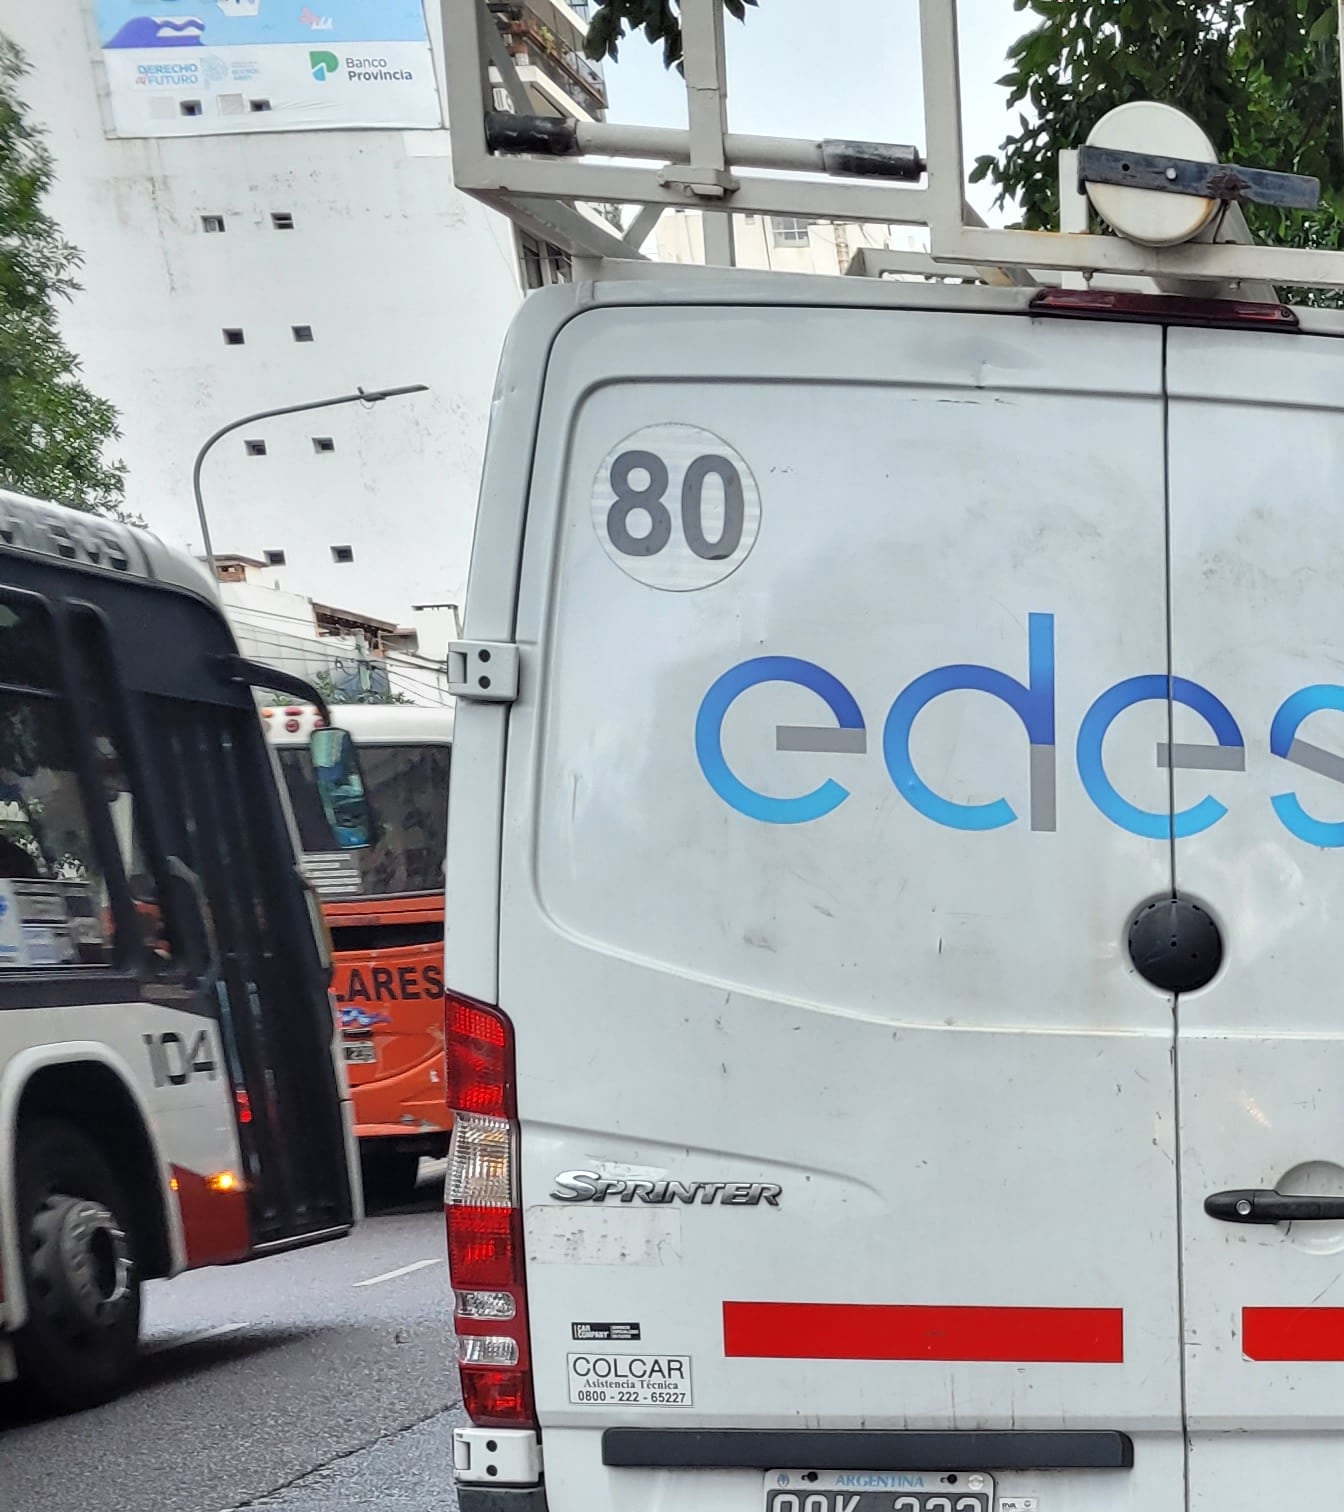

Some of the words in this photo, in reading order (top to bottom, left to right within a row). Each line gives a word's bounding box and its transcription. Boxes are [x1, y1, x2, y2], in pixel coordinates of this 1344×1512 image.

[138, 63, 198, 74] DERECHO
[346, 57, 387, 69] Banco
[148, 74, 199, 85] FUTURO
[348, 70, 413, 82] Provincia
[606, 449, 744, 561] 80
[336, 964, 445, 1001] ARES
[573, 1356, 684, 1379] COLCAR
[584, 1379, 635, 1389] Asistencia
[639, 1379, 678, 1389] Técnica
[578, 1390, 606, 1401] 0800
[618, 1391, 640, 1402] 222
[651, 1392, 686, 1403] 65227
[835, 1473, 925, 1488] ARGENTINA
